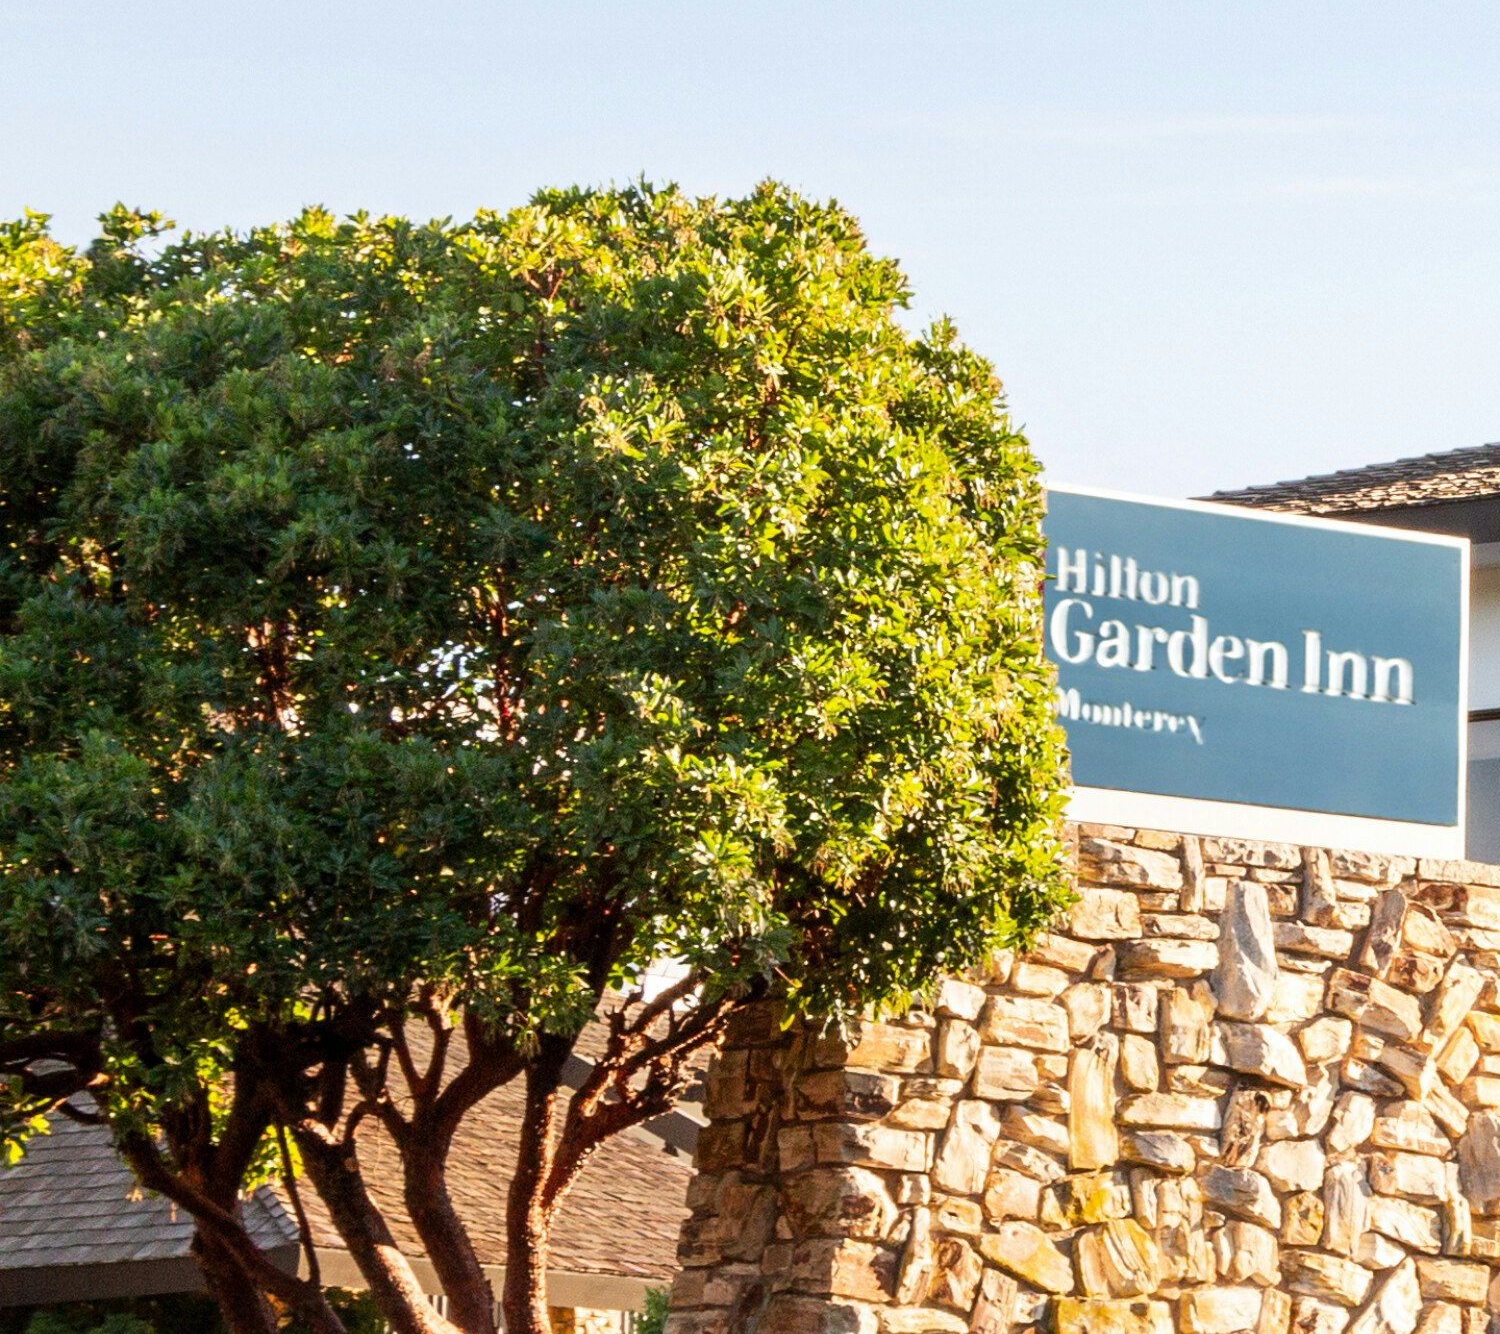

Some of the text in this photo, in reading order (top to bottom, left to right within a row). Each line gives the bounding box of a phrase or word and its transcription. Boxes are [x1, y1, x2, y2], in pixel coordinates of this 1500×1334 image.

[1054, 545, 1200, 610] Hilton
[1050, 597, 1417, 705] Garden Inn
[1054, 685, 1206, 745] Monterey
